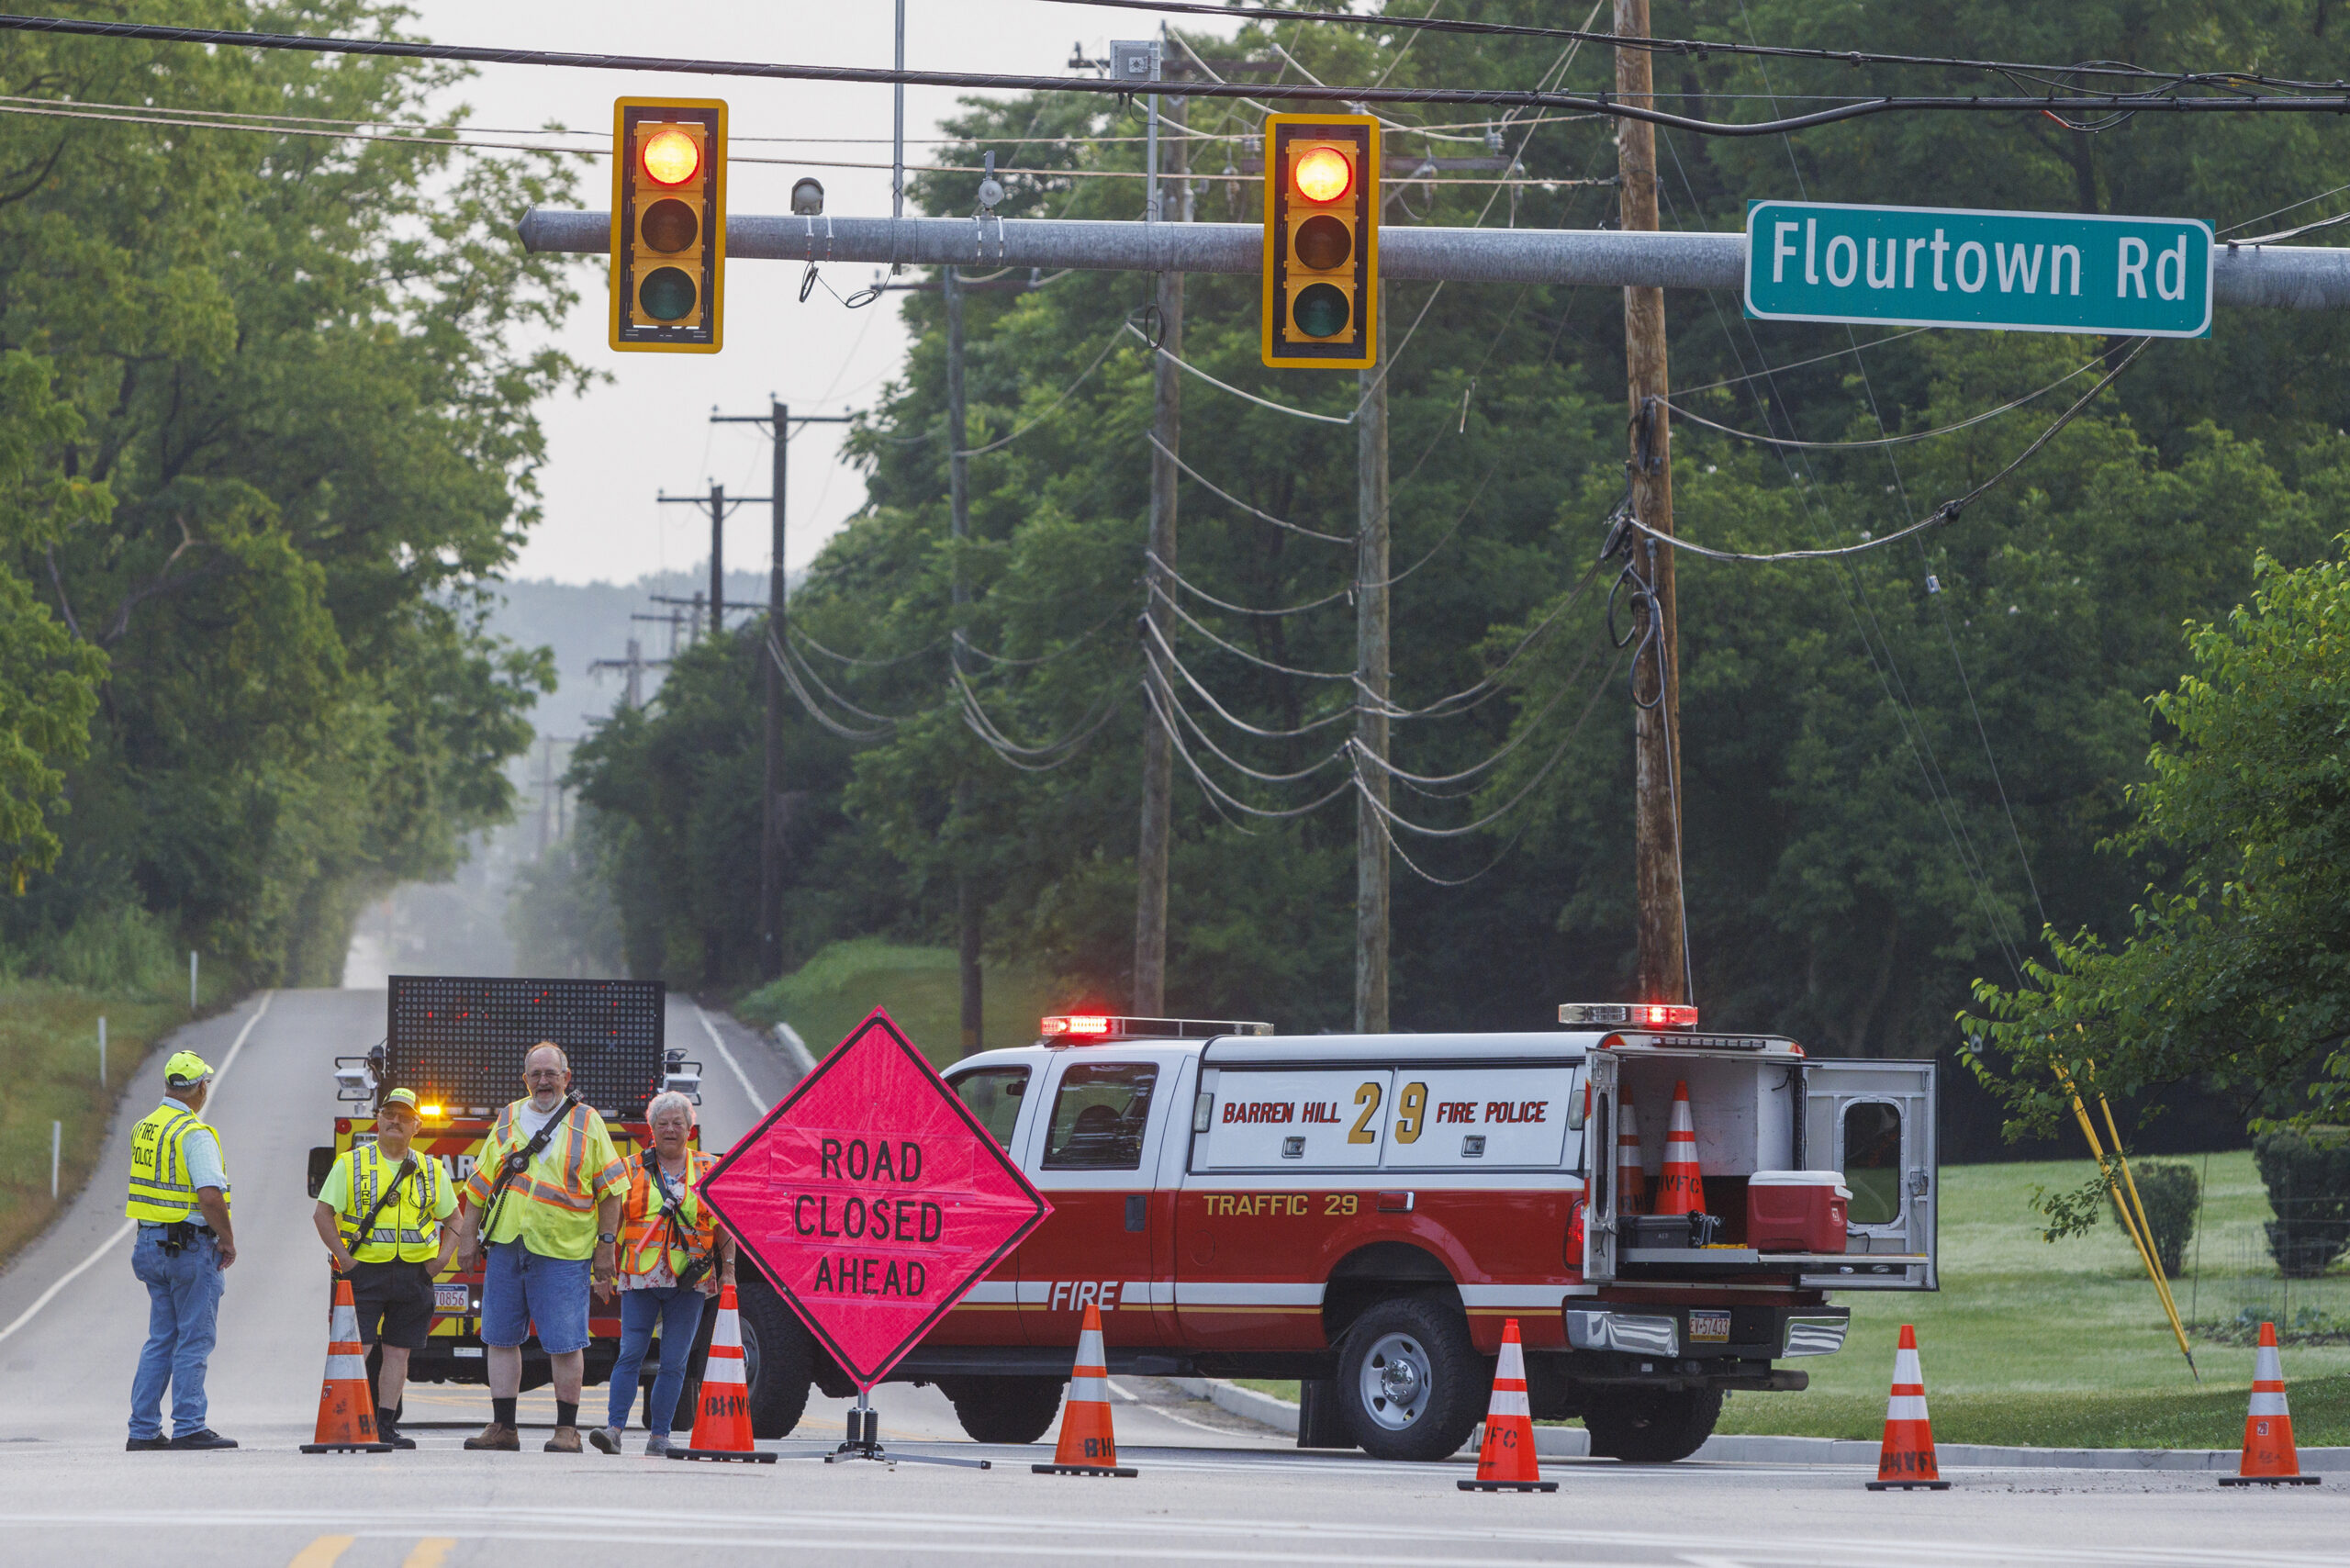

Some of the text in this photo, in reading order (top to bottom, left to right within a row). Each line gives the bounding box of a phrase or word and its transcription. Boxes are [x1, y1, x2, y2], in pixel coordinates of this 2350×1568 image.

[1772, 218, 2188, 301] Flourtown Rd
[1222, 1102, 1295, 1124] BARREN
[1301, 1102, 1341, 1123] HILL
[1436, 1102, 1479, 1123] FIRE
[1484, 1102, 1549, 1123] POLICE
[137, 1122, 159, 1141] FIRE
[132, 1146, 154, 1167] POLICE
[821, 1138, 923, 1182] ROAD
[360, 1174, 371, 1206] FIRE
[1203, 1194, 1359, 1215] TRAFFIC 29
[794, 1194, 943, 1243] CLOSED
[813, 1257, 926, 1296] AHEAD
[433, 1291, 464, 1306] 70856
[1051, 1281, 1119, 1312] FIRE
[1084, 1438, 1115, 1458] BH
